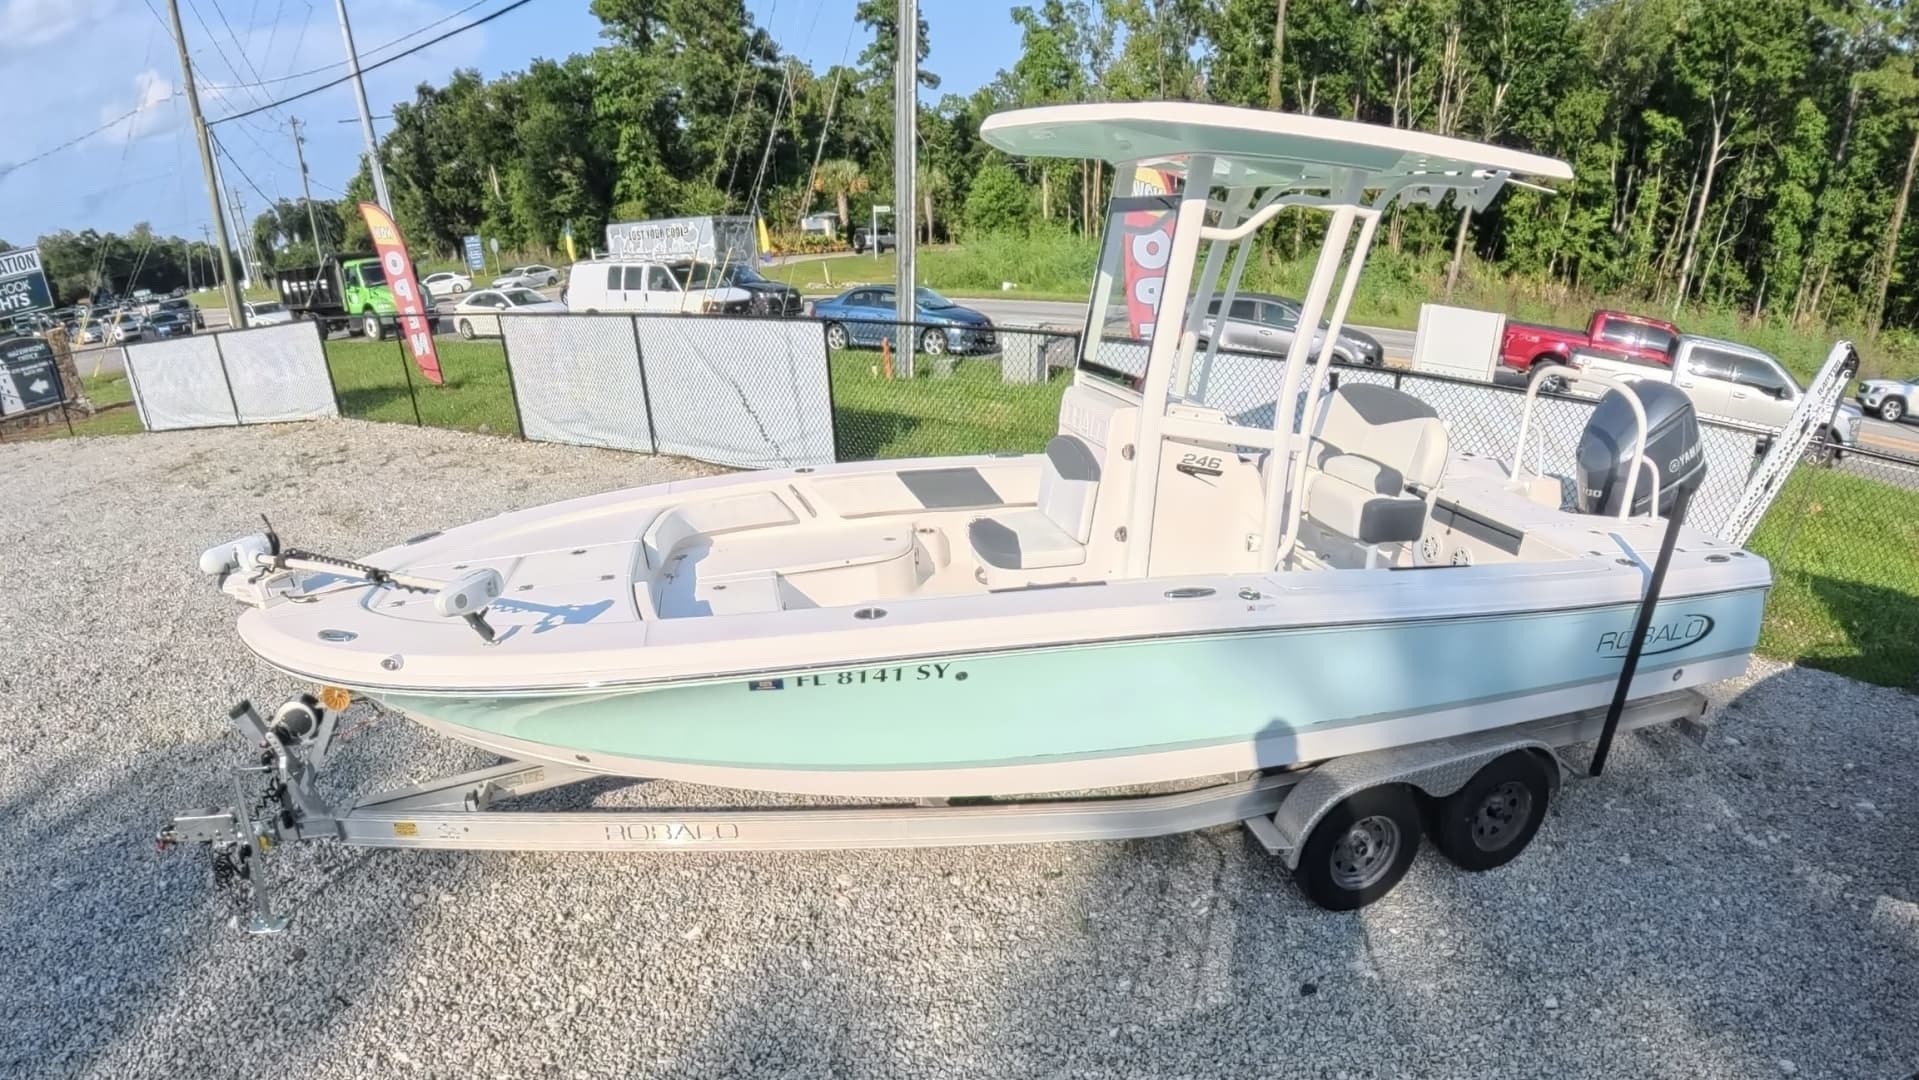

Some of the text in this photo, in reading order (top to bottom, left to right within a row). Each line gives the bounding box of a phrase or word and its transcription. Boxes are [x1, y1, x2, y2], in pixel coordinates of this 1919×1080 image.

[1182, 453, 1223, 469] 246
[796, 662, 951, 688] FL 8141 SY
[605, 823, 739, 842] ROBALO
